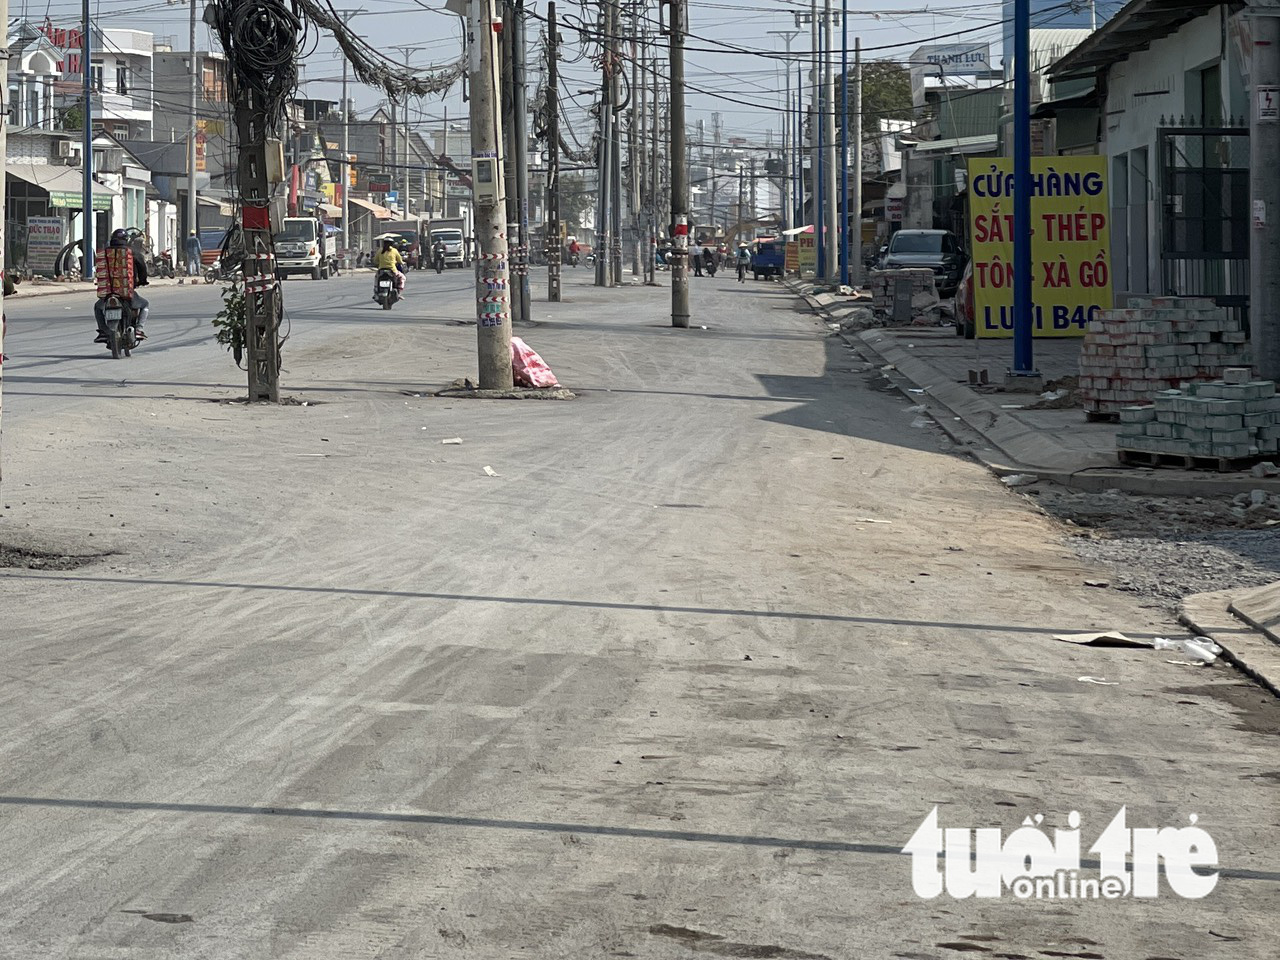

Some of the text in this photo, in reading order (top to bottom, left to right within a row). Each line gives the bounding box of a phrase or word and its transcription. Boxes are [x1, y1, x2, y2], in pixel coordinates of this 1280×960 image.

[973, 165, 1103, 197] CỬA HÀNG
[975, 202, 1106, 243] SẮT THÉP
[1042, 254, 1071, 288] XÀ
[1080, 249, 1108, 288] GỒ
